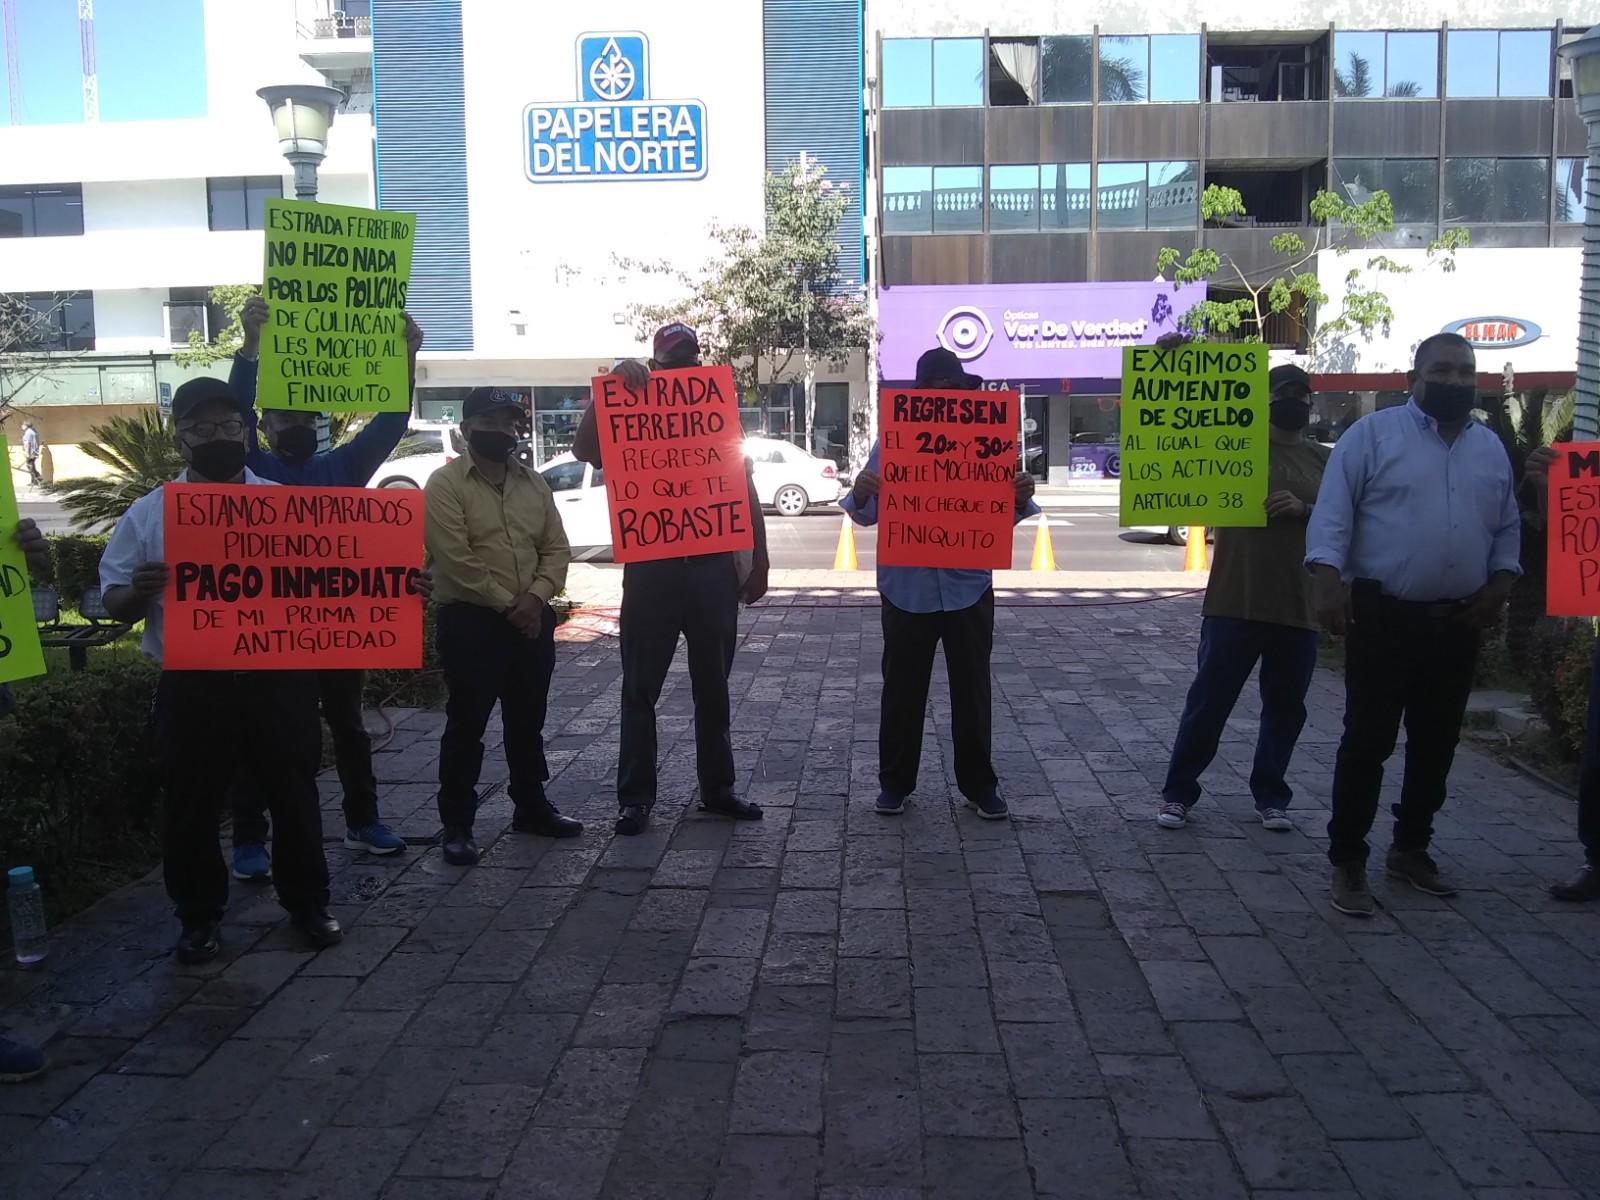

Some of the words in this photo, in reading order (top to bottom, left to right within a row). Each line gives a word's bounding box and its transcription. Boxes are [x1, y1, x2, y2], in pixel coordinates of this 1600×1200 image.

[533, 106, 696, 139] PAPELERA
[534, 142, 590, 173] DEL
[595, 140, 696, 172] NORTE
[269, 208, 343, 236] ESTRADA
[348, 216, 409, 240] FERREIRO
[268, 241, 297, 267] NO
[303, 242, 348, 267] HIZO
[353, 247, 397, 273] NADA
[268, 277, 303, 303] POR
[307, 279, 338, 303] LOS
[276, 309, 300, 328] DE
[305, 307, 396, 335] CULIACÁN
[1003, 320, 1039, 341] Ver
[1041, 320, 1069, 340] De
[1071, 318, 1146, 340] Verdad
[274, 335, 307, 356] LES
[316, 337, 377, 359] MOCHO
[382, 339, 402, 358] AL
[281, 358, 352, 378] CHEQUE
[366, 360, 382, 375] DE
[1132, 349, 1257, 376] EXIGIMOS
[287, 382, 391, 406] FINIQUITO
[602, 376, 724, 408] ESTRADA
[981, 382, 1010, 392] ICA
[1132, 377, 1251, 401] AUMENTO
[893, 394, 1007, 424] REGRESEN
[1140, 408, 1165, 426] DE
[1171, 406, 1254, 430] SUELDO
[610, 411, 724, 443] FERREIRO
[885, 431, 904, 449] EL
[960, 441, 973, 460] Y
[1125, 434, 1146, 451] AL
[1157, 435, 1205, 451] IGUAL
[1215, 435, 1253, 451] QUE
[622, 447, 721, 472] REGRESA
[934, 458, 1015, 484] MOCHARON
[1129, 462, 1162, 482] LOS
[1172, 459, 1254, 479] ACTIVOS
[1568, 450, 1600, 479] M
[612, 480, 639, 501] LO
[653, 478, 697, 498] QUE
[702, 475, 732, 495] TE
[1132, 492, 1208, 512] ARTICULO
[1218, 491, 1244, 509] 38
[176, 492, 277, 528] ESTAMOS
[284, 495, 413, 527] AMPARADOS
[886, 494, 898, 511] A
[903, 495, 920, 513] MI
[925, 495, 984, 513] CHEQUE
[991, 500, 1009, 514] DE
[617, 501, 745, 549] ROBASTE
[887, 521, 995, 550] FINIQUITO
[1561, 514, 1600, 556] RO
[224, 531, 332, 559] PIDIENDO
[338, 535, 363, 559] EL
[175, 562, 263, 602] PAGO
[193, 608, 224, 630] DE
[237, 609, 264, 626] MI
[286, 605, 356, 625] PRIMA
[370, 606, 399, 623] DE
[233, 627, 397, 656] ANTIGÜEDAD
